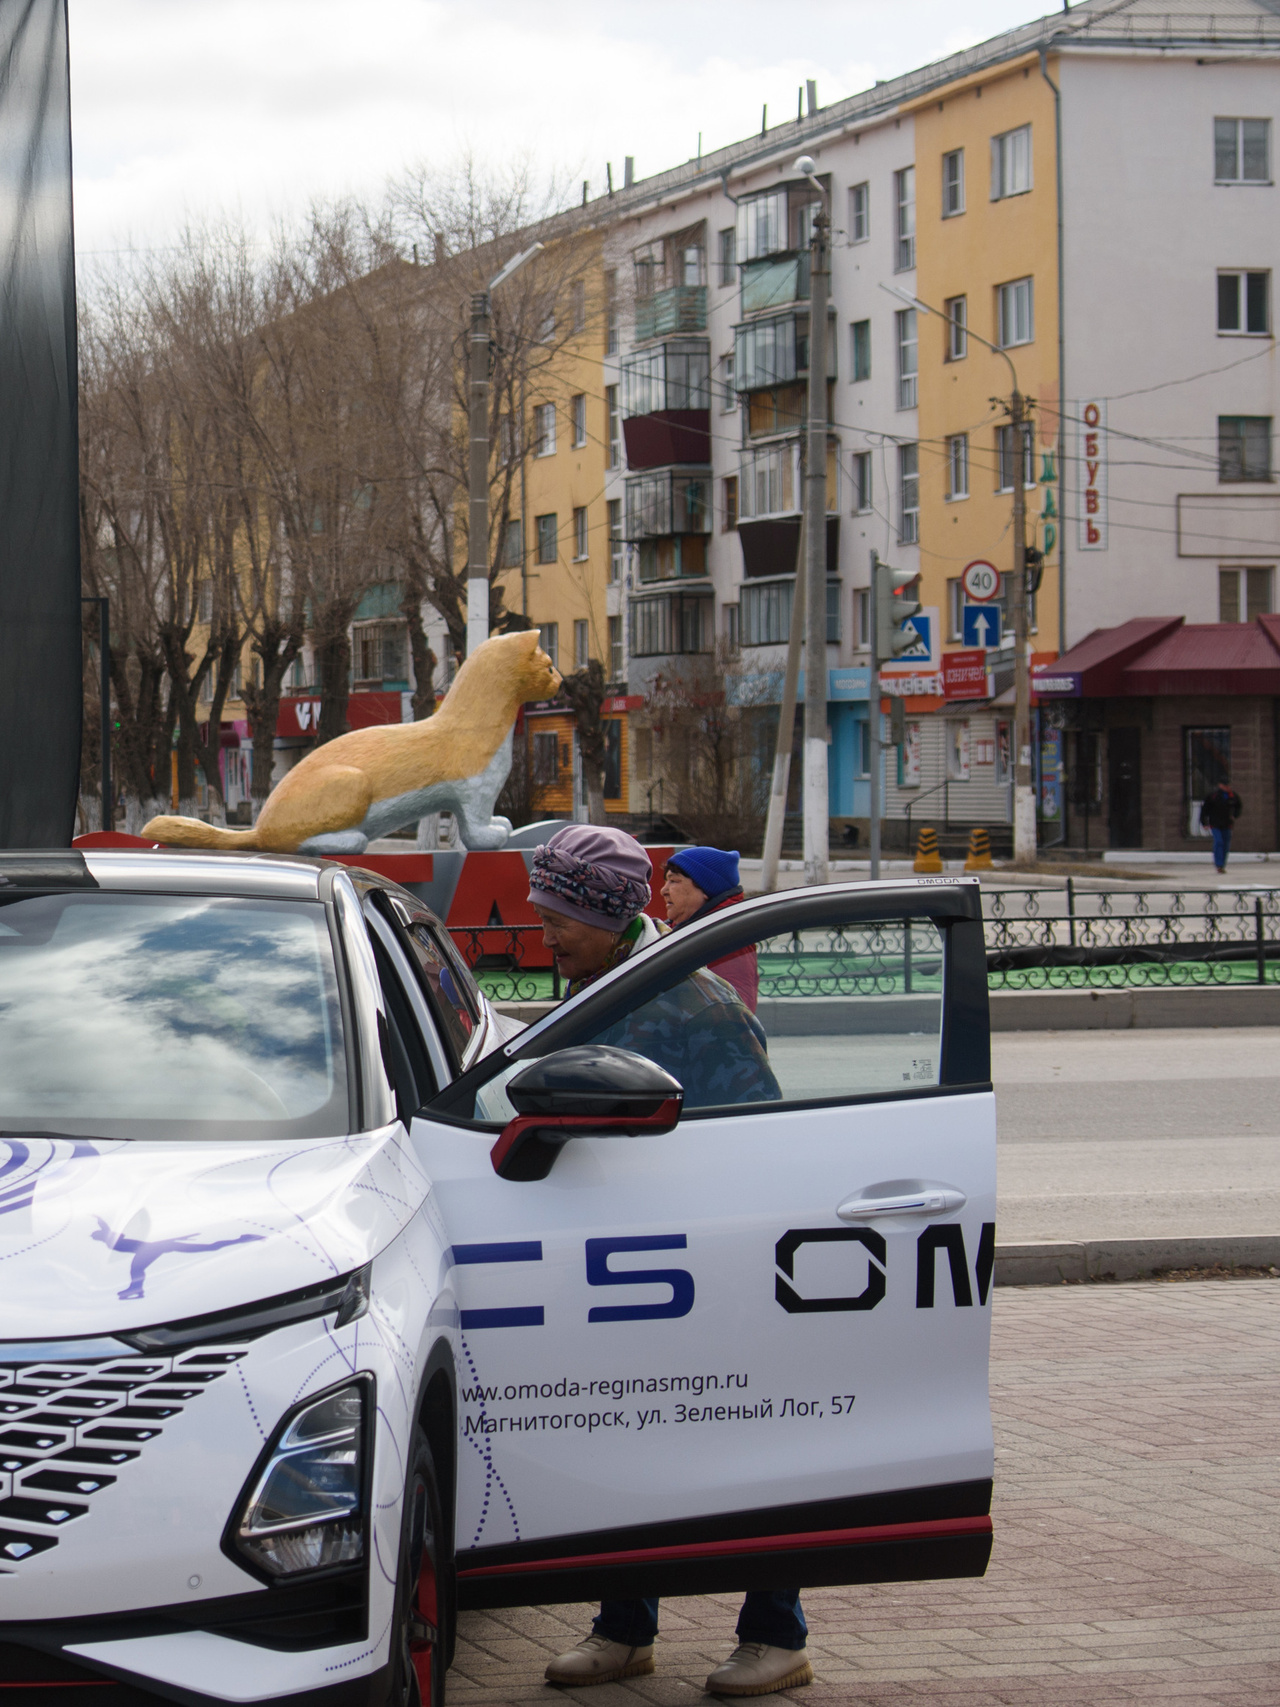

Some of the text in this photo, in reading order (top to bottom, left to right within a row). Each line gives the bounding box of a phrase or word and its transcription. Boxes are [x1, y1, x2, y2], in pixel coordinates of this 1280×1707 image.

[1084, 403, 1101, 545] ОБУВЬ
[971, 572, 992, 590] 40
[463, 1395, 856, 1434] Магнитогорск, ул. Зеленый Лог, 57
